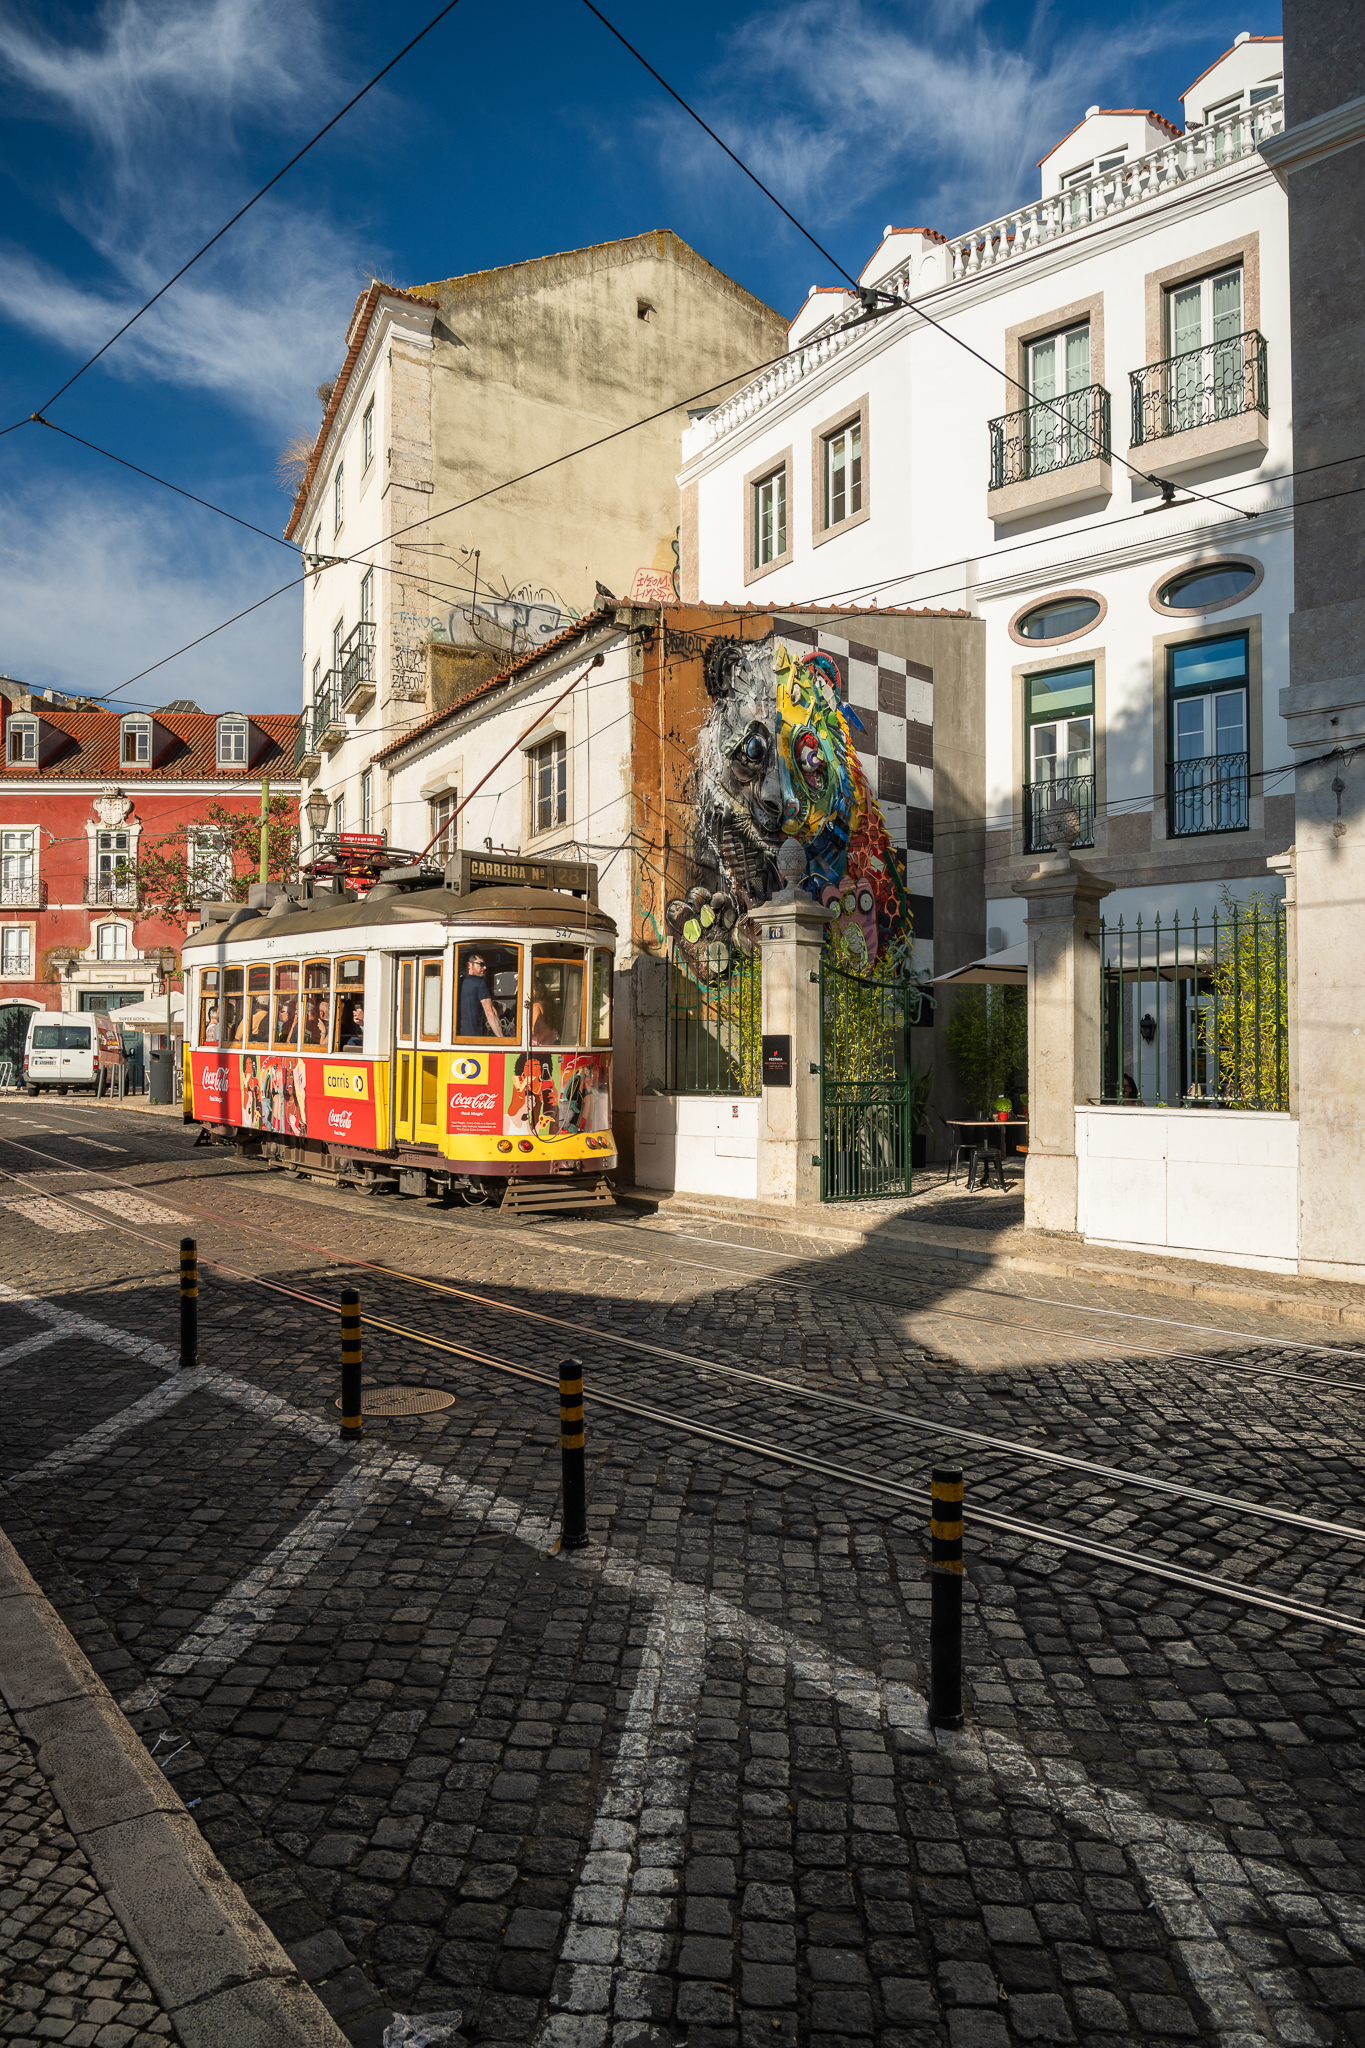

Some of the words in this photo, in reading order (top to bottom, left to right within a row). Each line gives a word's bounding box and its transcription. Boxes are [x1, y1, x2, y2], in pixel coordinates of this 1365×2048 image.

[471, 861, 526, 879] CARREIRA
[557, 867, 580, 884] 28
[556, 930, 573, 938] 547
[771, 927, 781, 938] 76
[202, 1065, 229, 1092] Coca-Cola
[327, 1073, 350, 1089] carris
[449, 1092, 499, 1109] Coca-Cola
[328, 1108, 353, 1129] Coca-Cola
